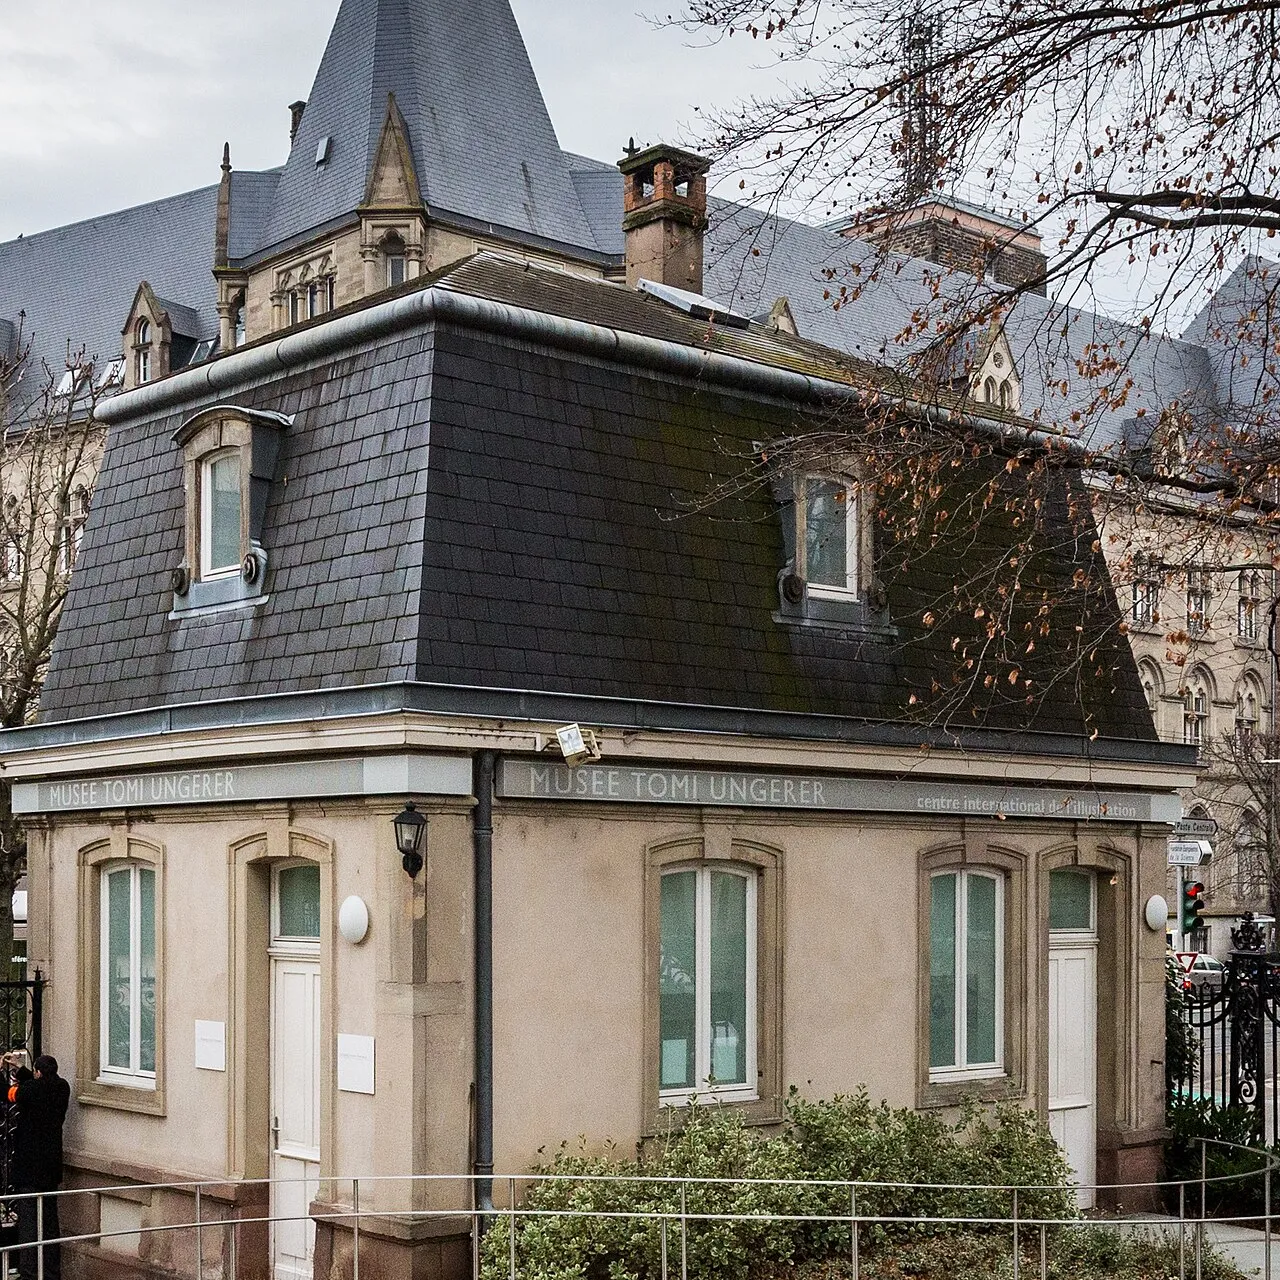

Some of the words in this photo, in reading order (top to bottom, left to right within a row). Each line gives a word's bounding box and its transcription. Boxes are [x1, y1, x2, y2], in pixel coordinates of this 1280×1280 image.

[49, 781, 98, 807] MUSEE
[104, 778, 144, 804] TOMI
[151, 771, 236, 801] UNGERER
[529, 767, 620, 796] MUSEE
[631, 772, 699, 800] TOMI
[710, 776, 827, 805] UNGERER
[917, 796, 960, 810] centre
[964, 796, 1045, 814] international
[1066, 799, 1136, 817] l'illustation
